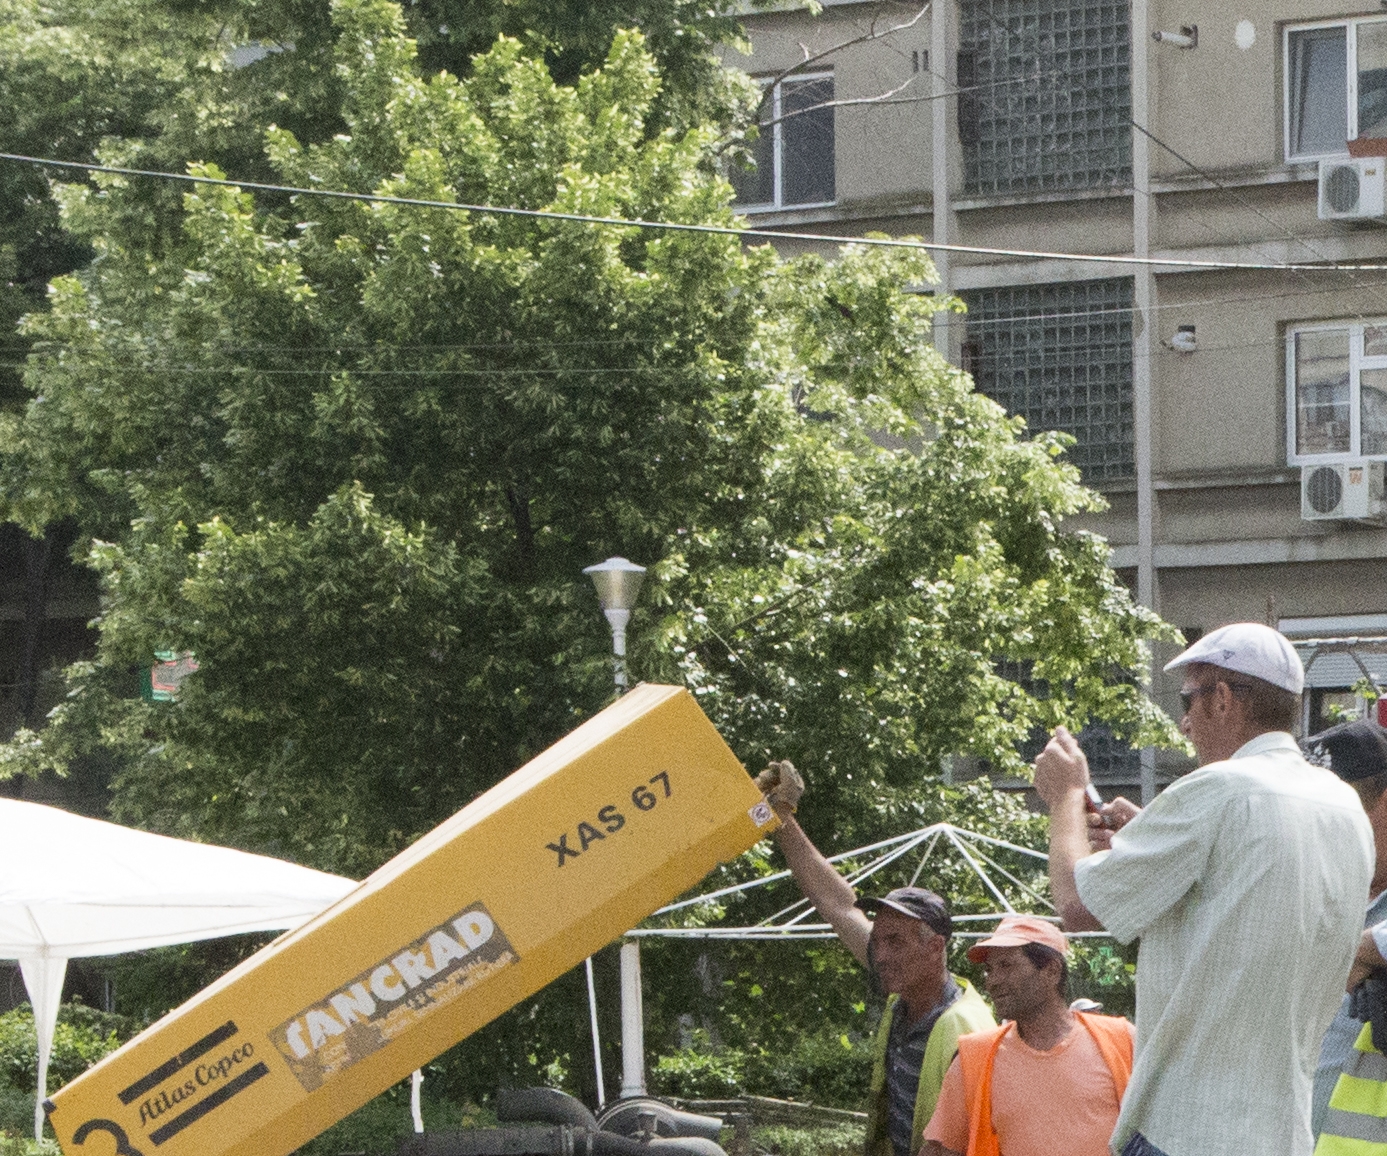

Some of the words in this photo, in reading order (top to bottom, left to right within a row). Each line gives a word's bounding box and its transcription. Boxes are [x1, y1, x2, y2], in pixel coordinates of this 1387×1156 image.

[545, 804, 626, 868] XAS
[631, 770, 675, 813] 67
[138, 1073, 195, 1128] Atlas
[195, 1040, 254, 1088] Copco
